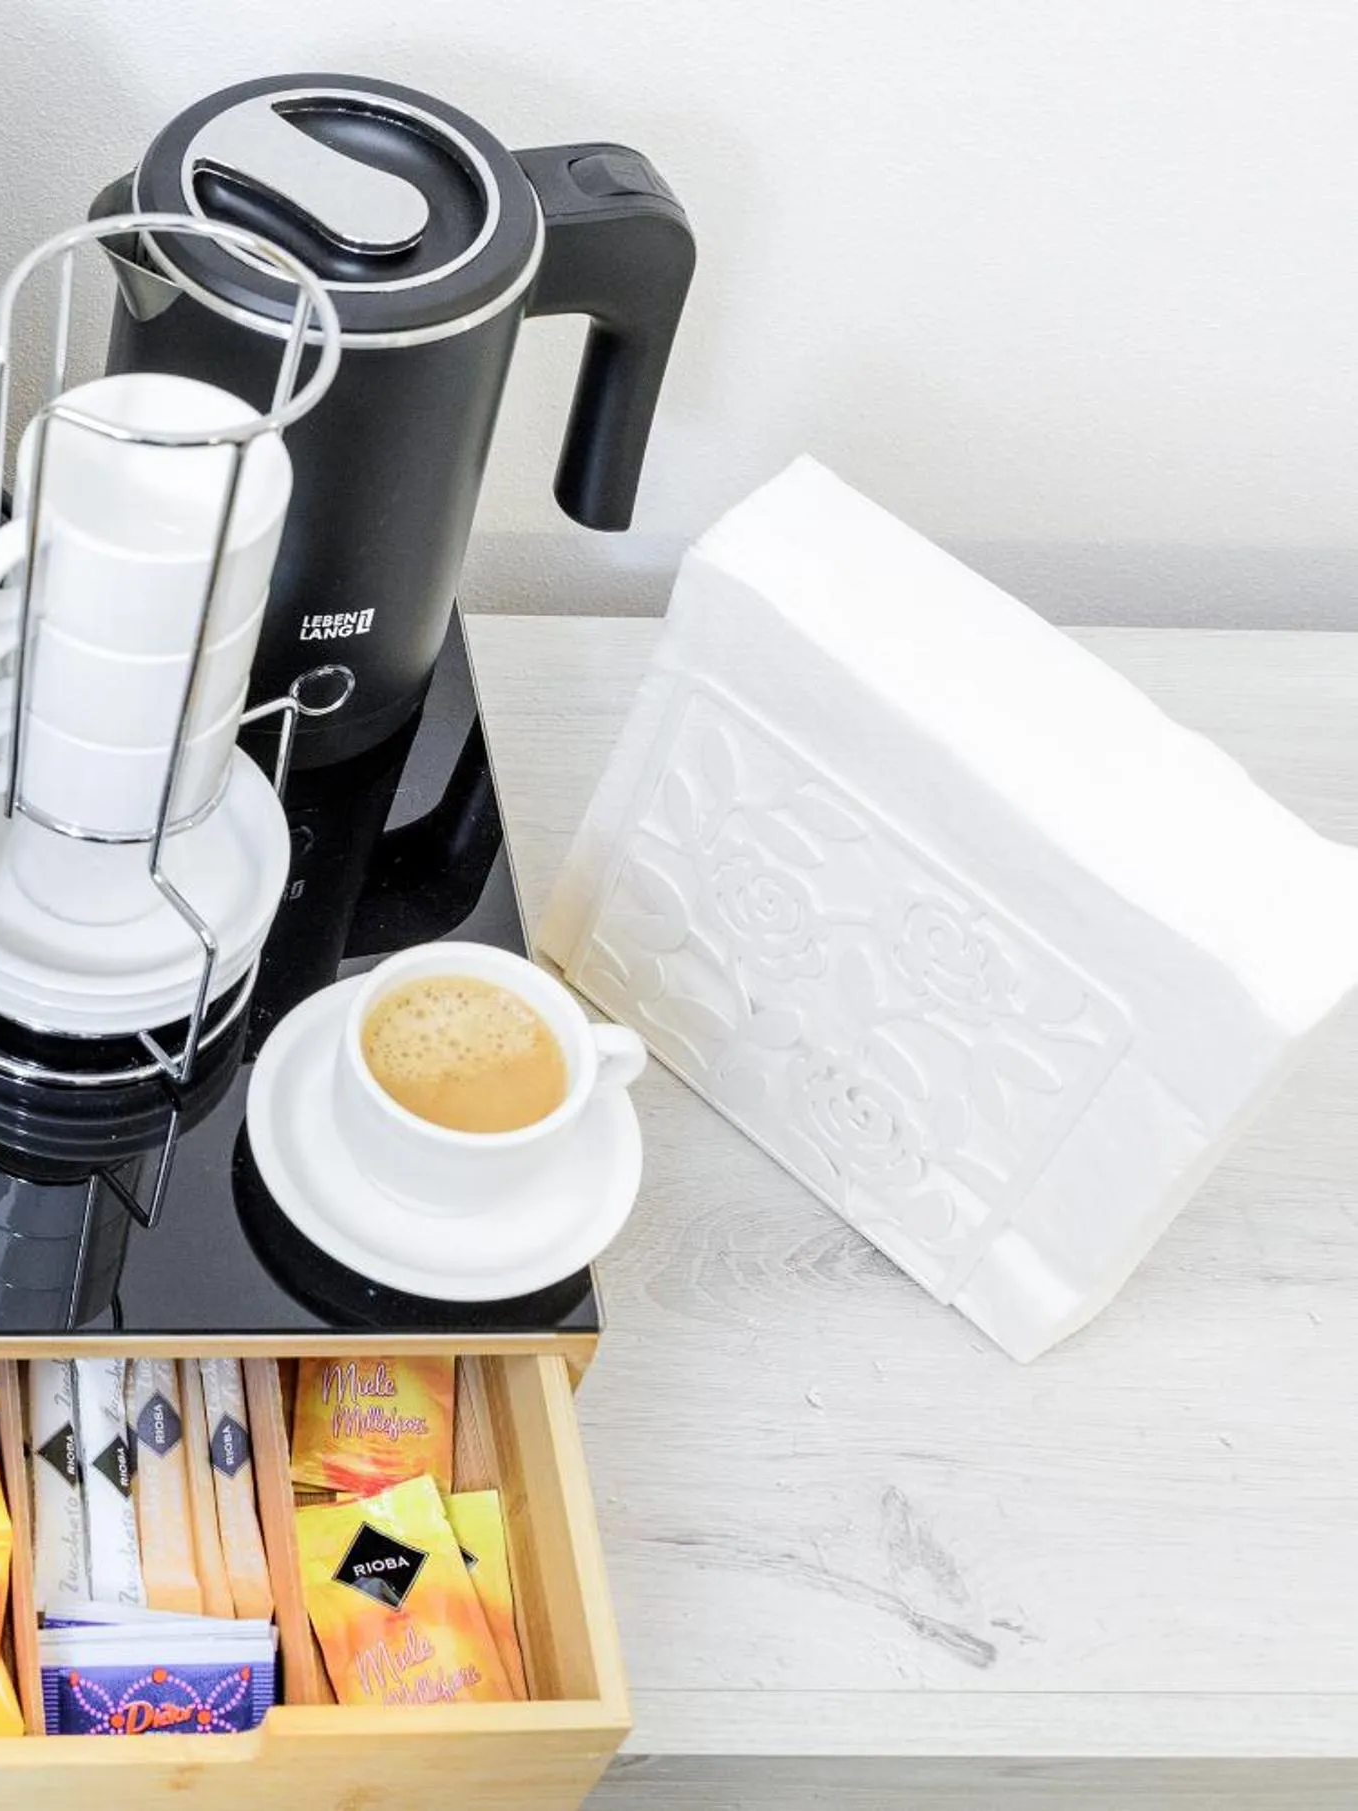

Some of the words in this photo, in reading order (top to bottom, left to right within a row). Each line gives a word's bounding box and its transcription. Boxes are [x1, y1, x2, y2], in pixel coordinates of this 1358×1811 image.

[300, 624, 354, 640] LANG
[302, 612, 359, 628] LEBEN
[322, 1362, 397, 1405] Miele
[153, 1404, 165, 1444] RIOBA
[65, 1435, 77, 1475] RIOBA
[221, 1424, 236, 1465] RIOBA
[116, 1447, 129, 1486] RIOBA
[353, 1556, 411, 1577] RIOBA
